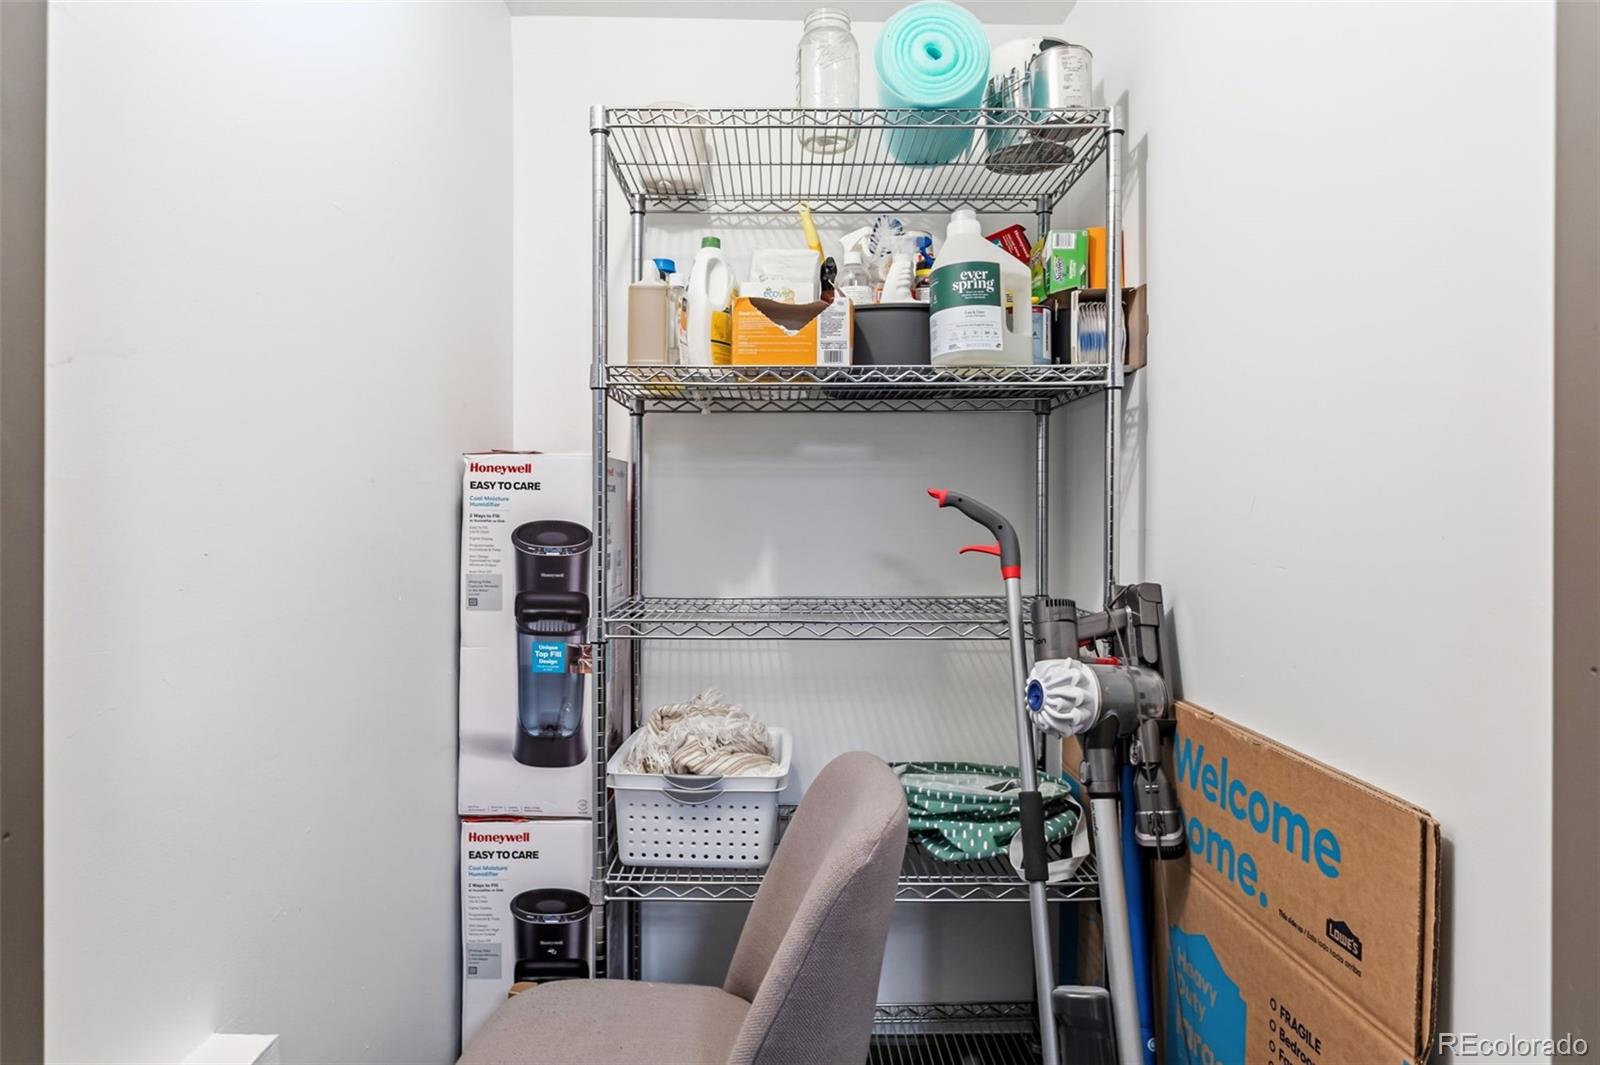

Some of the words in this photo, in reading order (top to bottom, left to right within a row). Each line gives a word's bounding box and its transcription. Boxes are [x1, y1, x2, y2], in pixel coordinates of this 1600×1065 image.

[960, 270, 988, 280] ever
[952, 278, 995, 294] spring
[469, 463, 532, 475] Honeywell
[469, 481, 495, 490] EASY
[498, 482, 512, 490] TO
[513, 482, 541, 491] CARE
[534, 650, 549, 659] Top
[1174, 732, 1342, 879] Welcome
[468, 832, 530, 844] Honeywell
[468, 851, 496, 859] EASY
[496, 851, 511, 859] TO
[511, 851, 539, 859] CARE
[1181, 808, 1269, 909] ome.
[1328, 922, 1359, 955] LOWE'S
[1178, 945, 1217, 1008] Heavy
[1279, 1004, 1322, 1056] FRAGILE
[1279, 1026, 1316, 1065] Bedroo
